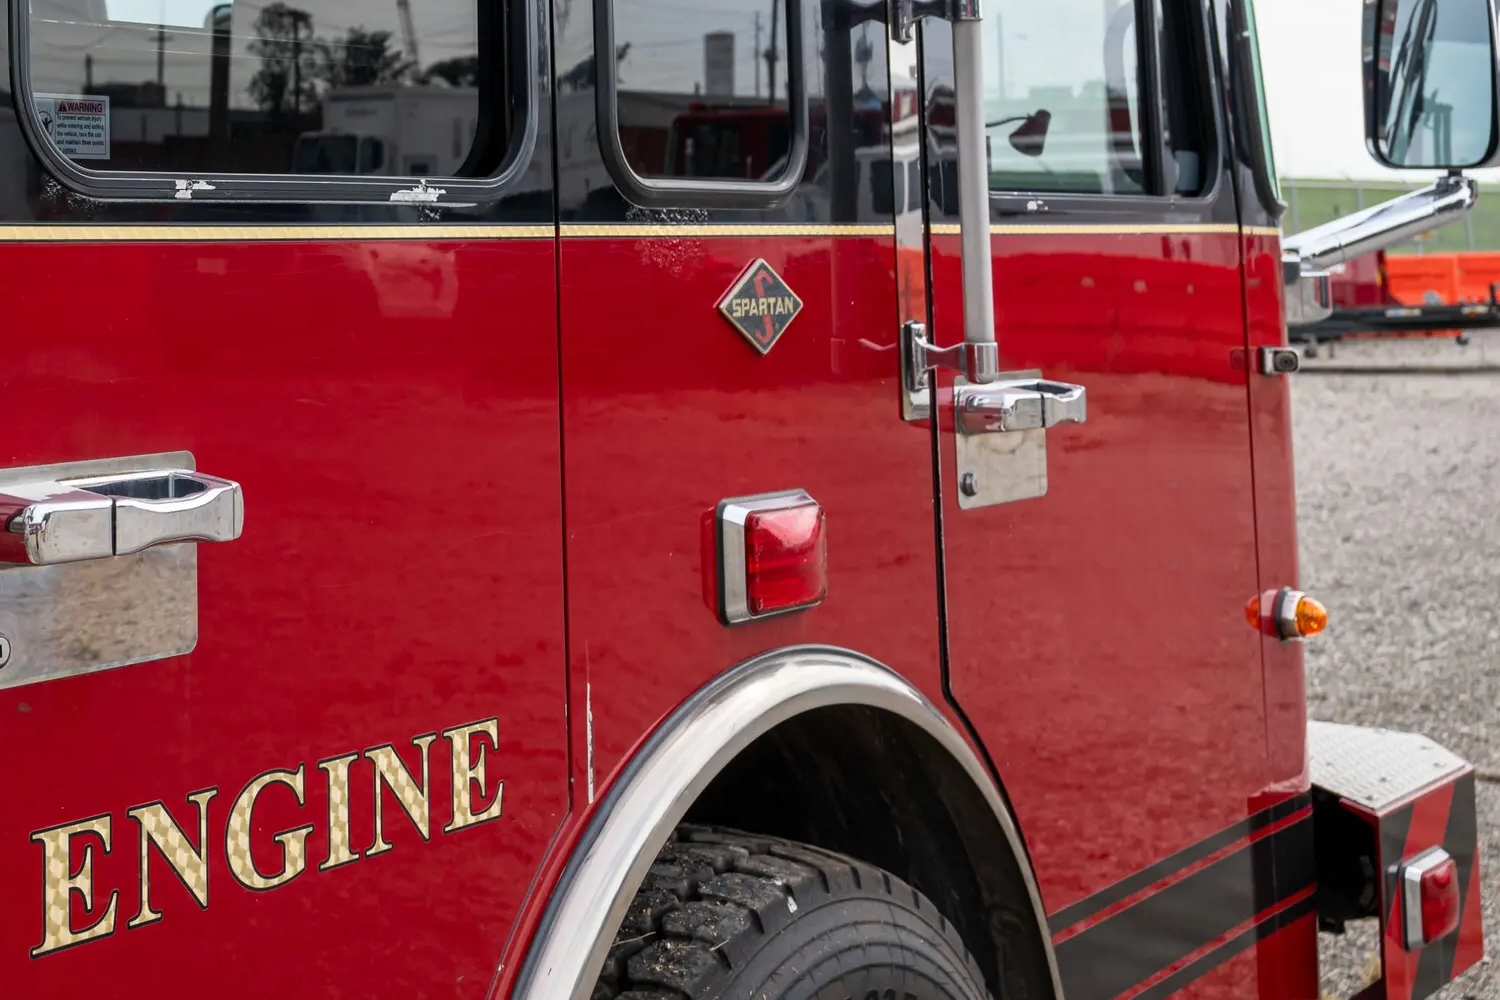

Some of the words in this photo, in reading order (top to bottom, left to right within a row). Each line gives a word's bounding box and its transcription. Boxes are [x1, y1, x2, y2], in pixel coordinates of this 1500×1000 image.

[67, 101, 103, 113] WARNING
[732, 297, 794, 317] SPARTAN
[29, 716, 504, 958] ENGINE
